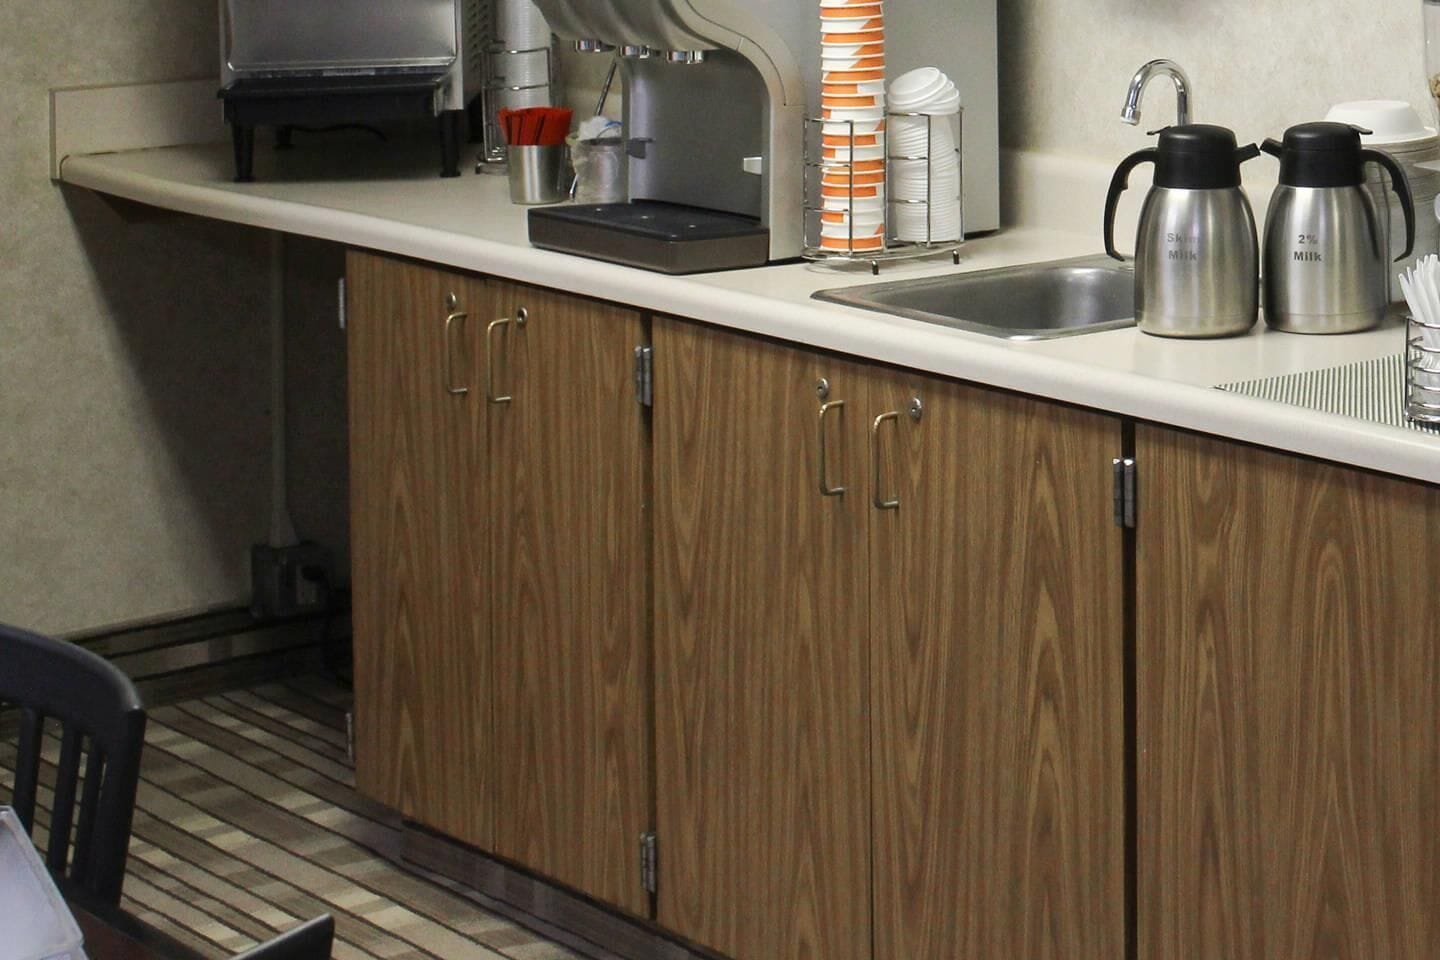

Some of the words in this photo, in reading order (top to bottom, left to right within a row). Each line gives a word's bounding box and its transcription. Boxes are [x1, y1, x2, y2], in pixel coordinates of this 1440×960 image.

[1298, 234, 1318, 245] 2%
[1168, 250, 1198, 261] Milk
[1293, 250, 1322, 262] Milk
